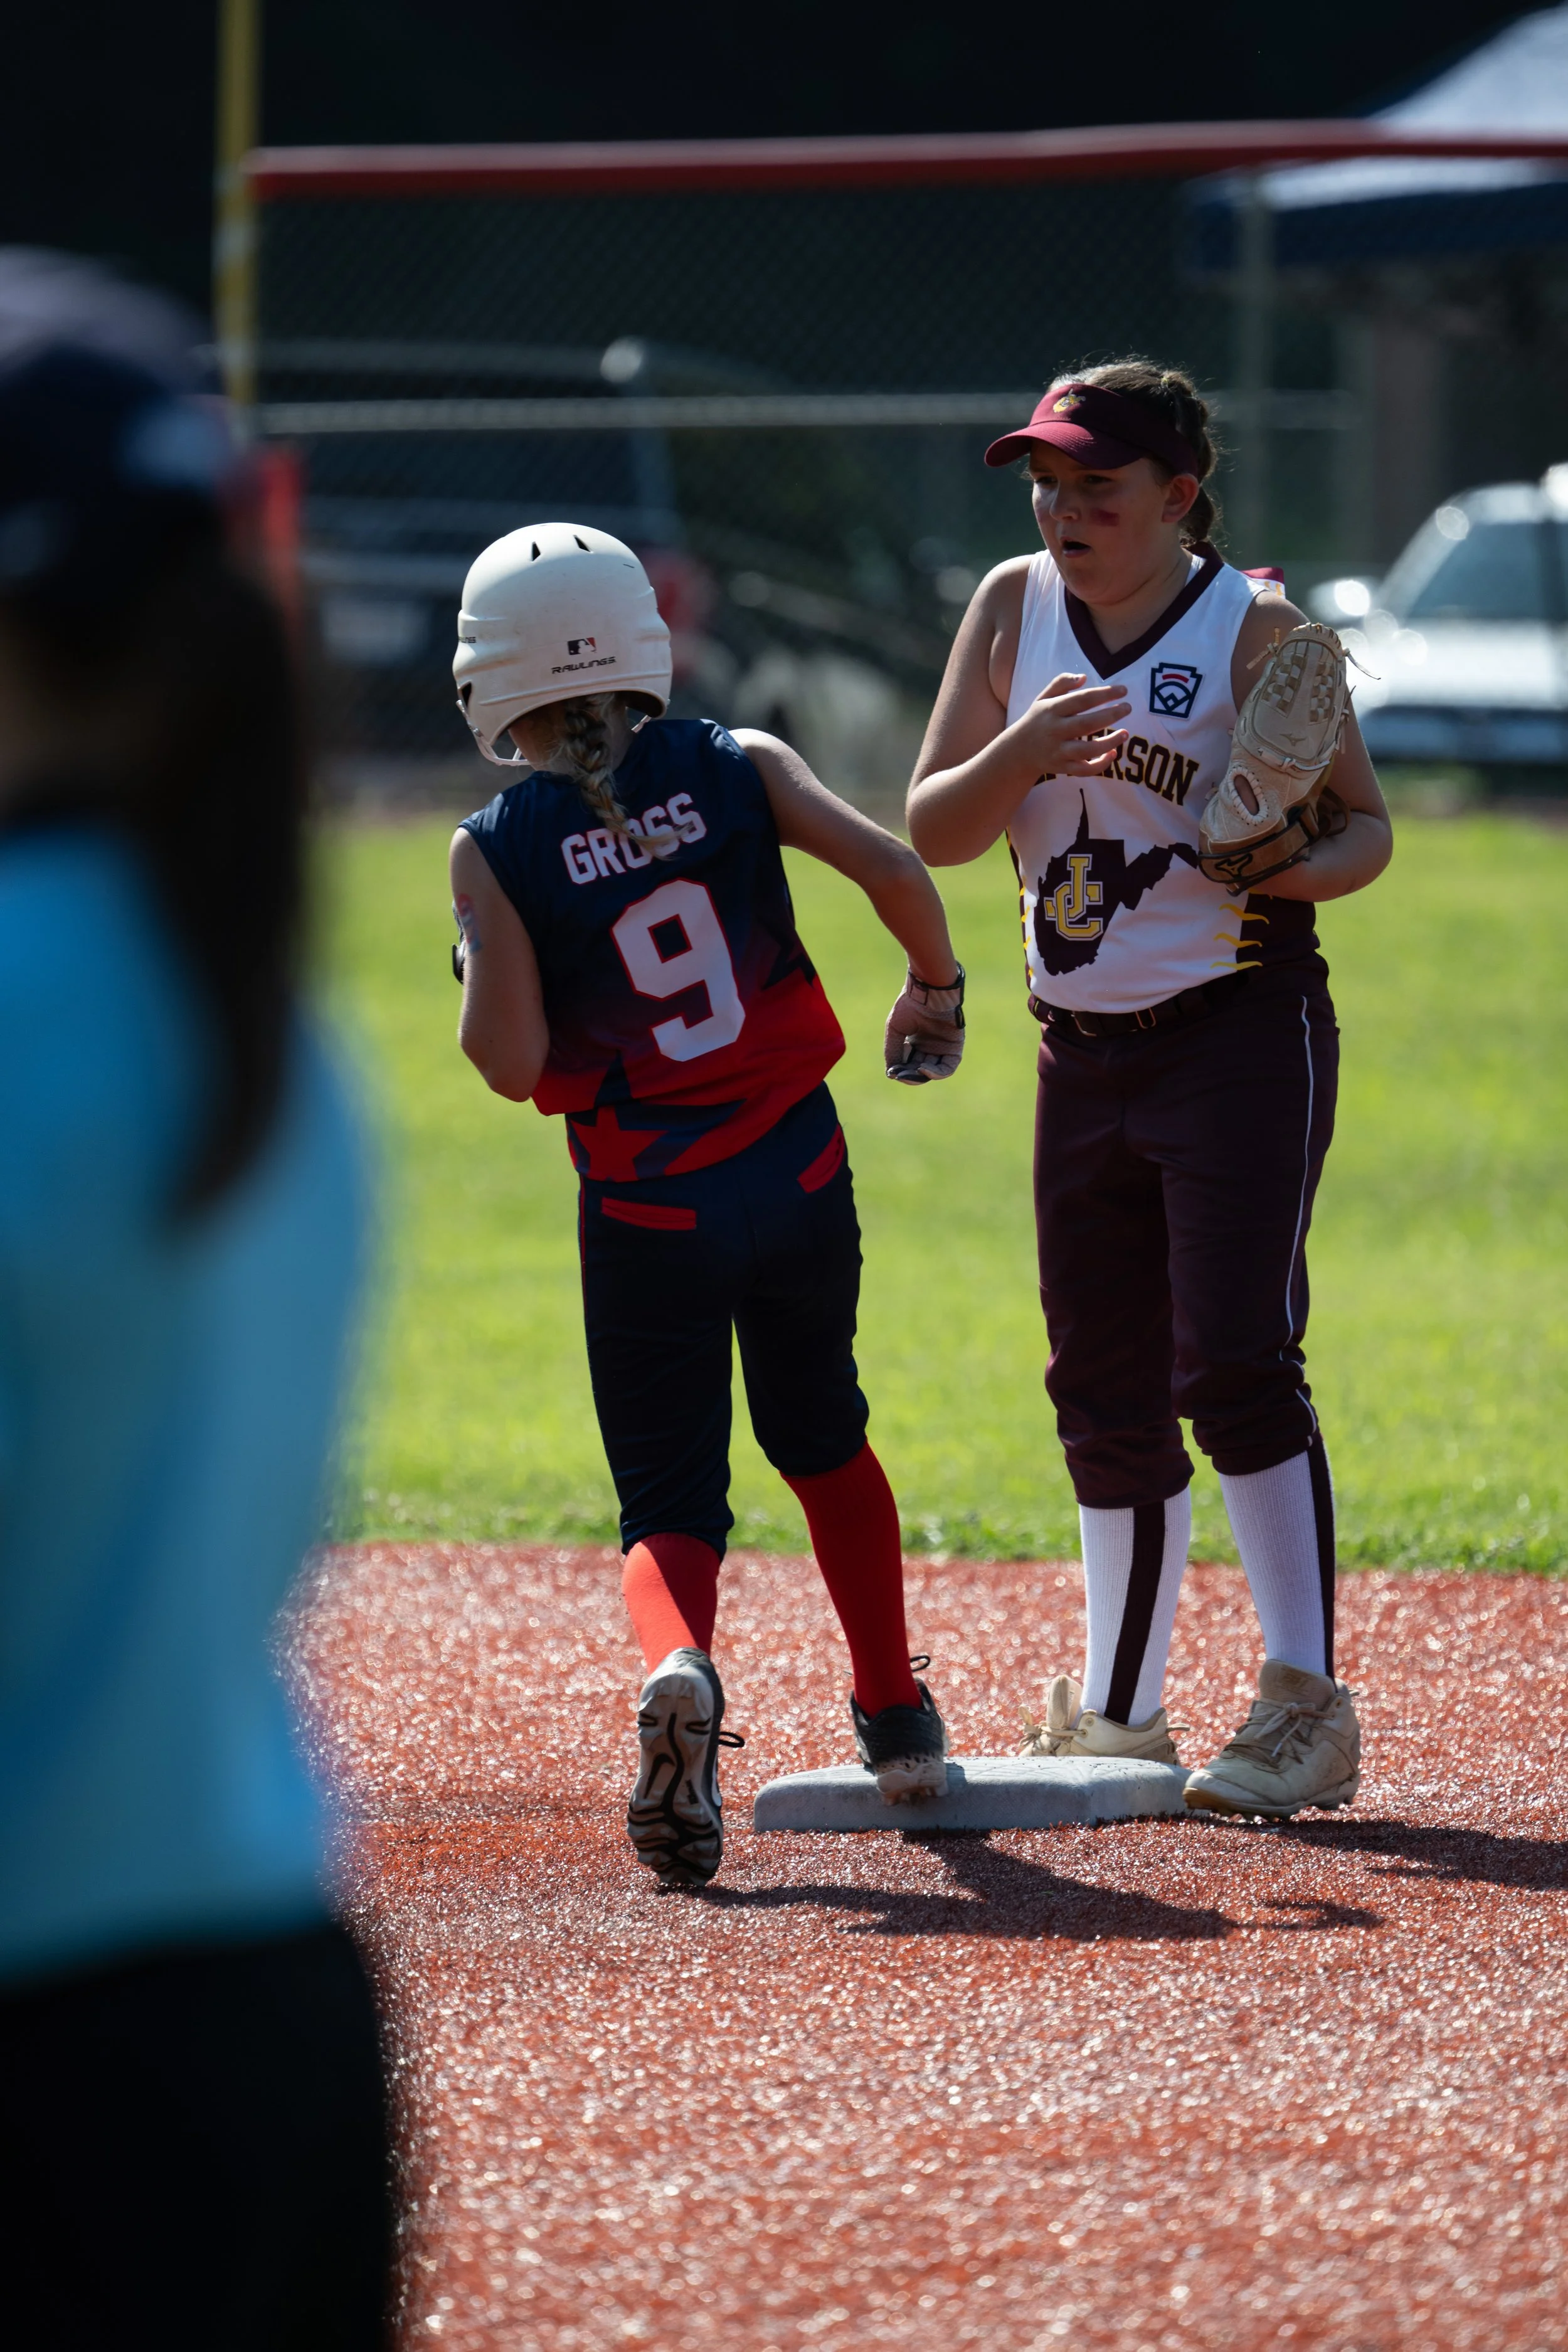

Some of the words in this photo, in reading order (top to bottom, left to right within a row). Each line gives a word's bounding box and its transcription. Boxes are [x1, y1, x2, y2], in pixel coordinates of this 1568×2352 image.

[551, 656, 617, 674] RAWLINGS
[560, 792, 707, 886] GROSS
[1044, 854, 1103, 941] JC
[609, 877, 746, 1062] 9
